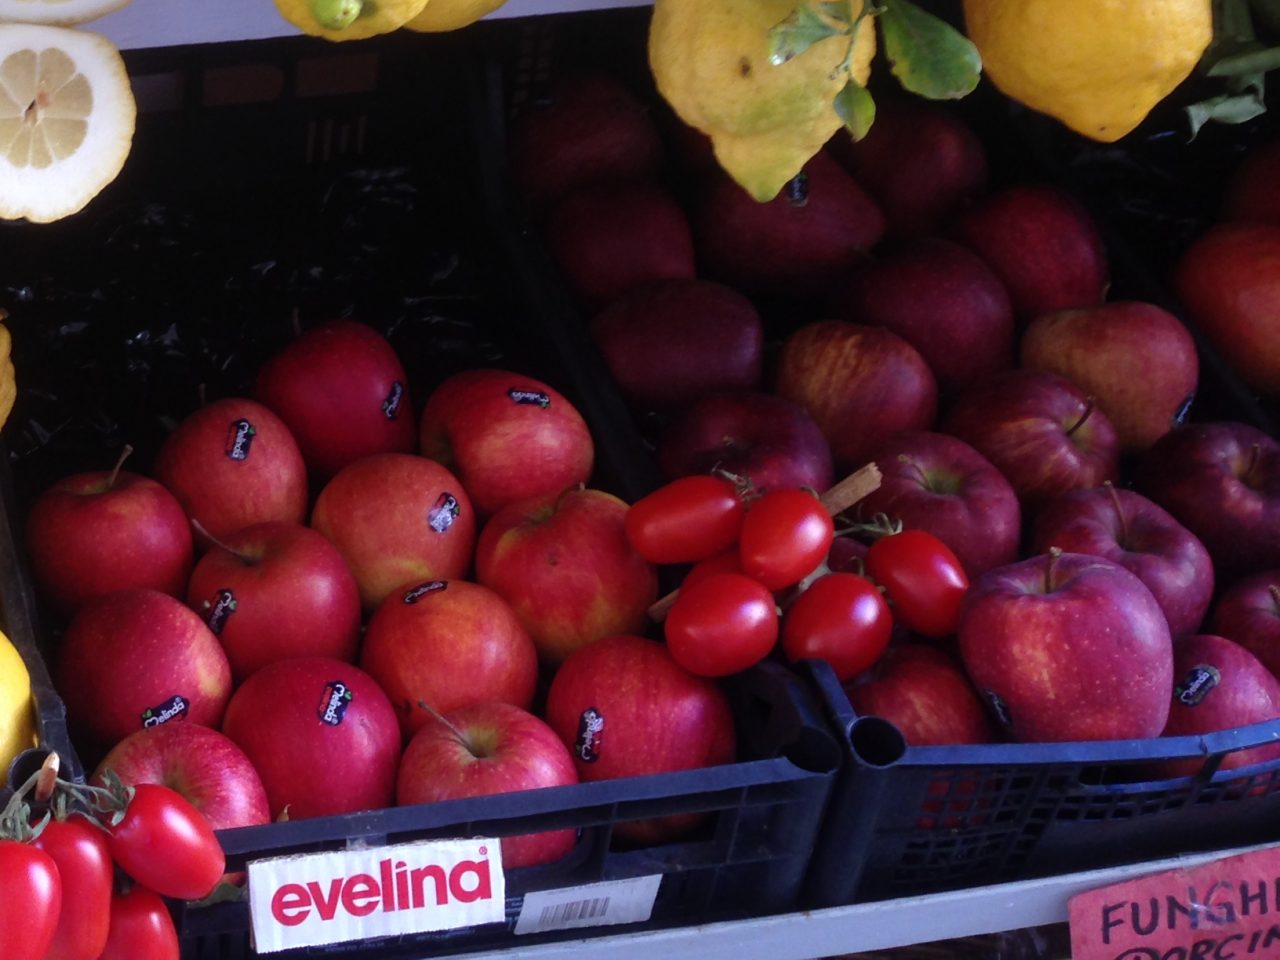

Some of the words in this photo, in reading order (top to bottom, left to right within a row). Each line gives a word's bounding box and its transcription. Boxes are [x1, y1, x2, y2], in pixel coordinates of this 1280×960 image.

[231, 421, 250, 459] Melinda
[324, 684, 345, 721] Melinda
[1180, 671, 1210, 703] Melinda
[144, 701, 186, 727] Melinda
[581, 711, 598, 760] Melinda
[271, 856, 492, 927] evelina
